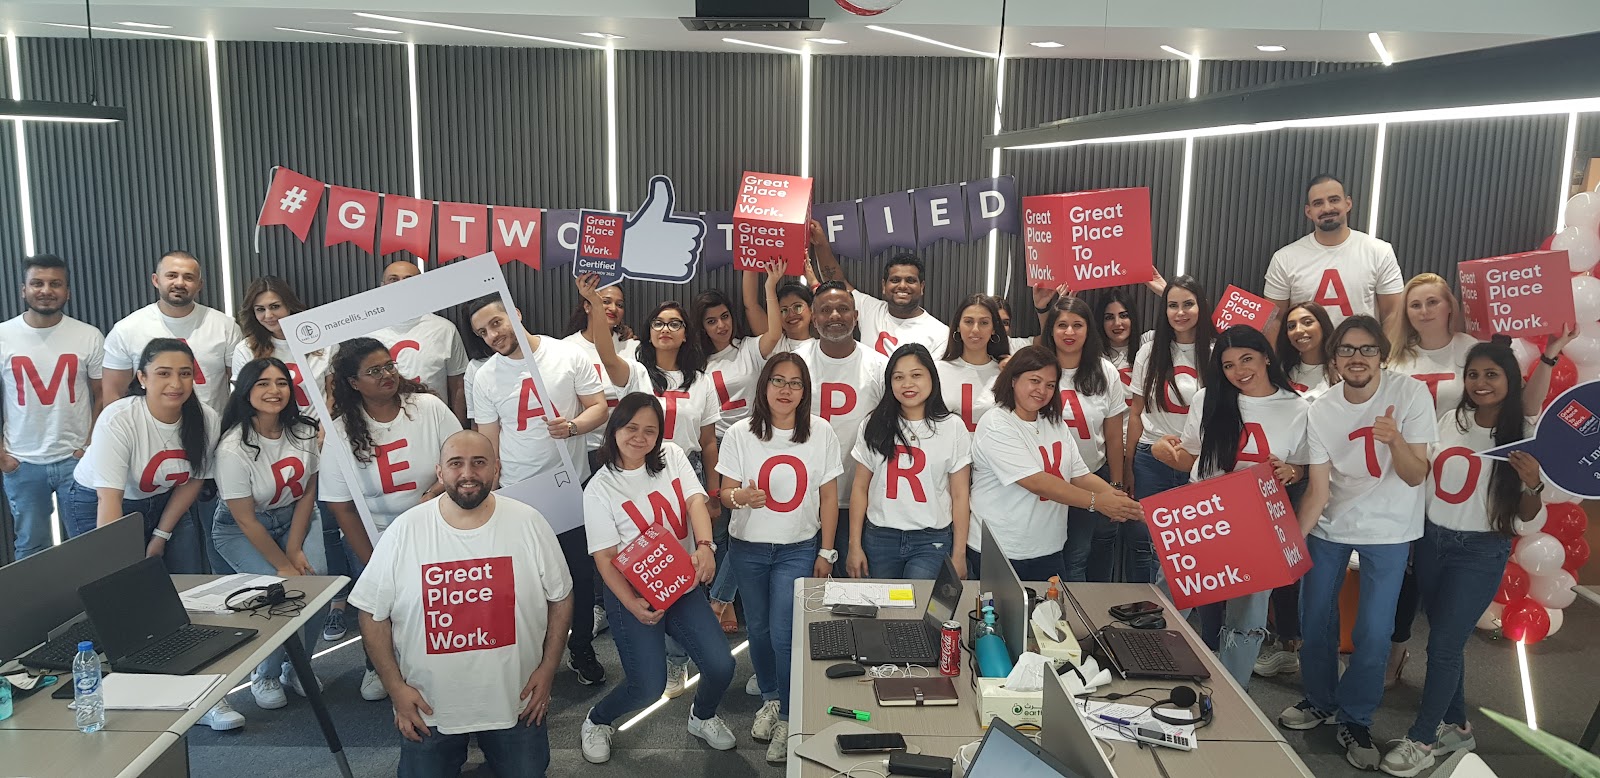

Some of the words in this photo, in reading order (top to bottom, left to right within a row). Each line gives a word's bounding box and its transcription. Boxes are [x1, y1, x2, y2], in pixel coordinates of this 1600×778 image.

[743, 185, 787, 198] Place
[745, 176, 789, 188] Great
[741, 194, 757, 204] To
[586, 216, 616, 227] Great
[1025, 209, 1052, 225] Great
[1069, 203, 1124, 223] Great
[584, 234, 596, 244] To
[585, 225, 615, 236] Place
[738, 222, 785, 237] Great
[1027, 227, 1052, 243] Place
[1071, 224, 1124, 243] Place
[739, 245, 757, 256] To
[740, 234, 785, 248] Place
[1027, 245, 1038, 260] To
[1071, 245, 1093, 261] To
[579, 259, 616, 270] Certified
[1486, 264, 1542, 284] Great
[1459, 270, 1477, 284] Great
[1230, 291, 1262, 312] Great
[1313, 268, 1354, 317] A
[1461, 285, 1478, 300] Place
[1489, 282, 1543, 300] Place
[1221, 309, 1233, 321] To
[1225, 299, 1255, 320] Place
[1462, 301, 1471, 314] To
[1489, 302, 1511, 316] To
[324, 306, 386, 331] marcellis_insta
[10, 353, 78, 407] M
[712, 370, 747, 411] L
[1411, 372, 1456, 411] T
[517, 377, 561, 432] A
[820, 382, 857, 423] P
[653, 389, 690, 440] T
[1059, 389, 1091, 439] A
[1232, 422, 1271, 471] A
[1348, 426, 1382, 479] T
[139, 449, 191, 493] G
[375, 438, 417, 495] E
[886, 444, 928, 503] R
[1432, 446, 1483, 505] O
[269, 456, 305, 505] R
[757, 454, 808, 513] O
[1258, 476, 1279, 498] Great
[621, 476, 689, 541] W
[1152, 493, 1225, 528] Great
[1266, 500, 1287, 521] Place
[1160, 519, 1232, 551] Place
[1274, 524, 1286, 544] To
[632, 543, 668, 574] Great
[640, 554, 675, 584] Place
[1166, 552, 1197, 573] To
[425, 563, 493, 586] Great
[647, 579, 664, 593] To
[427, 587, 493, 608] Place
[427, 610, 453, 629] To
